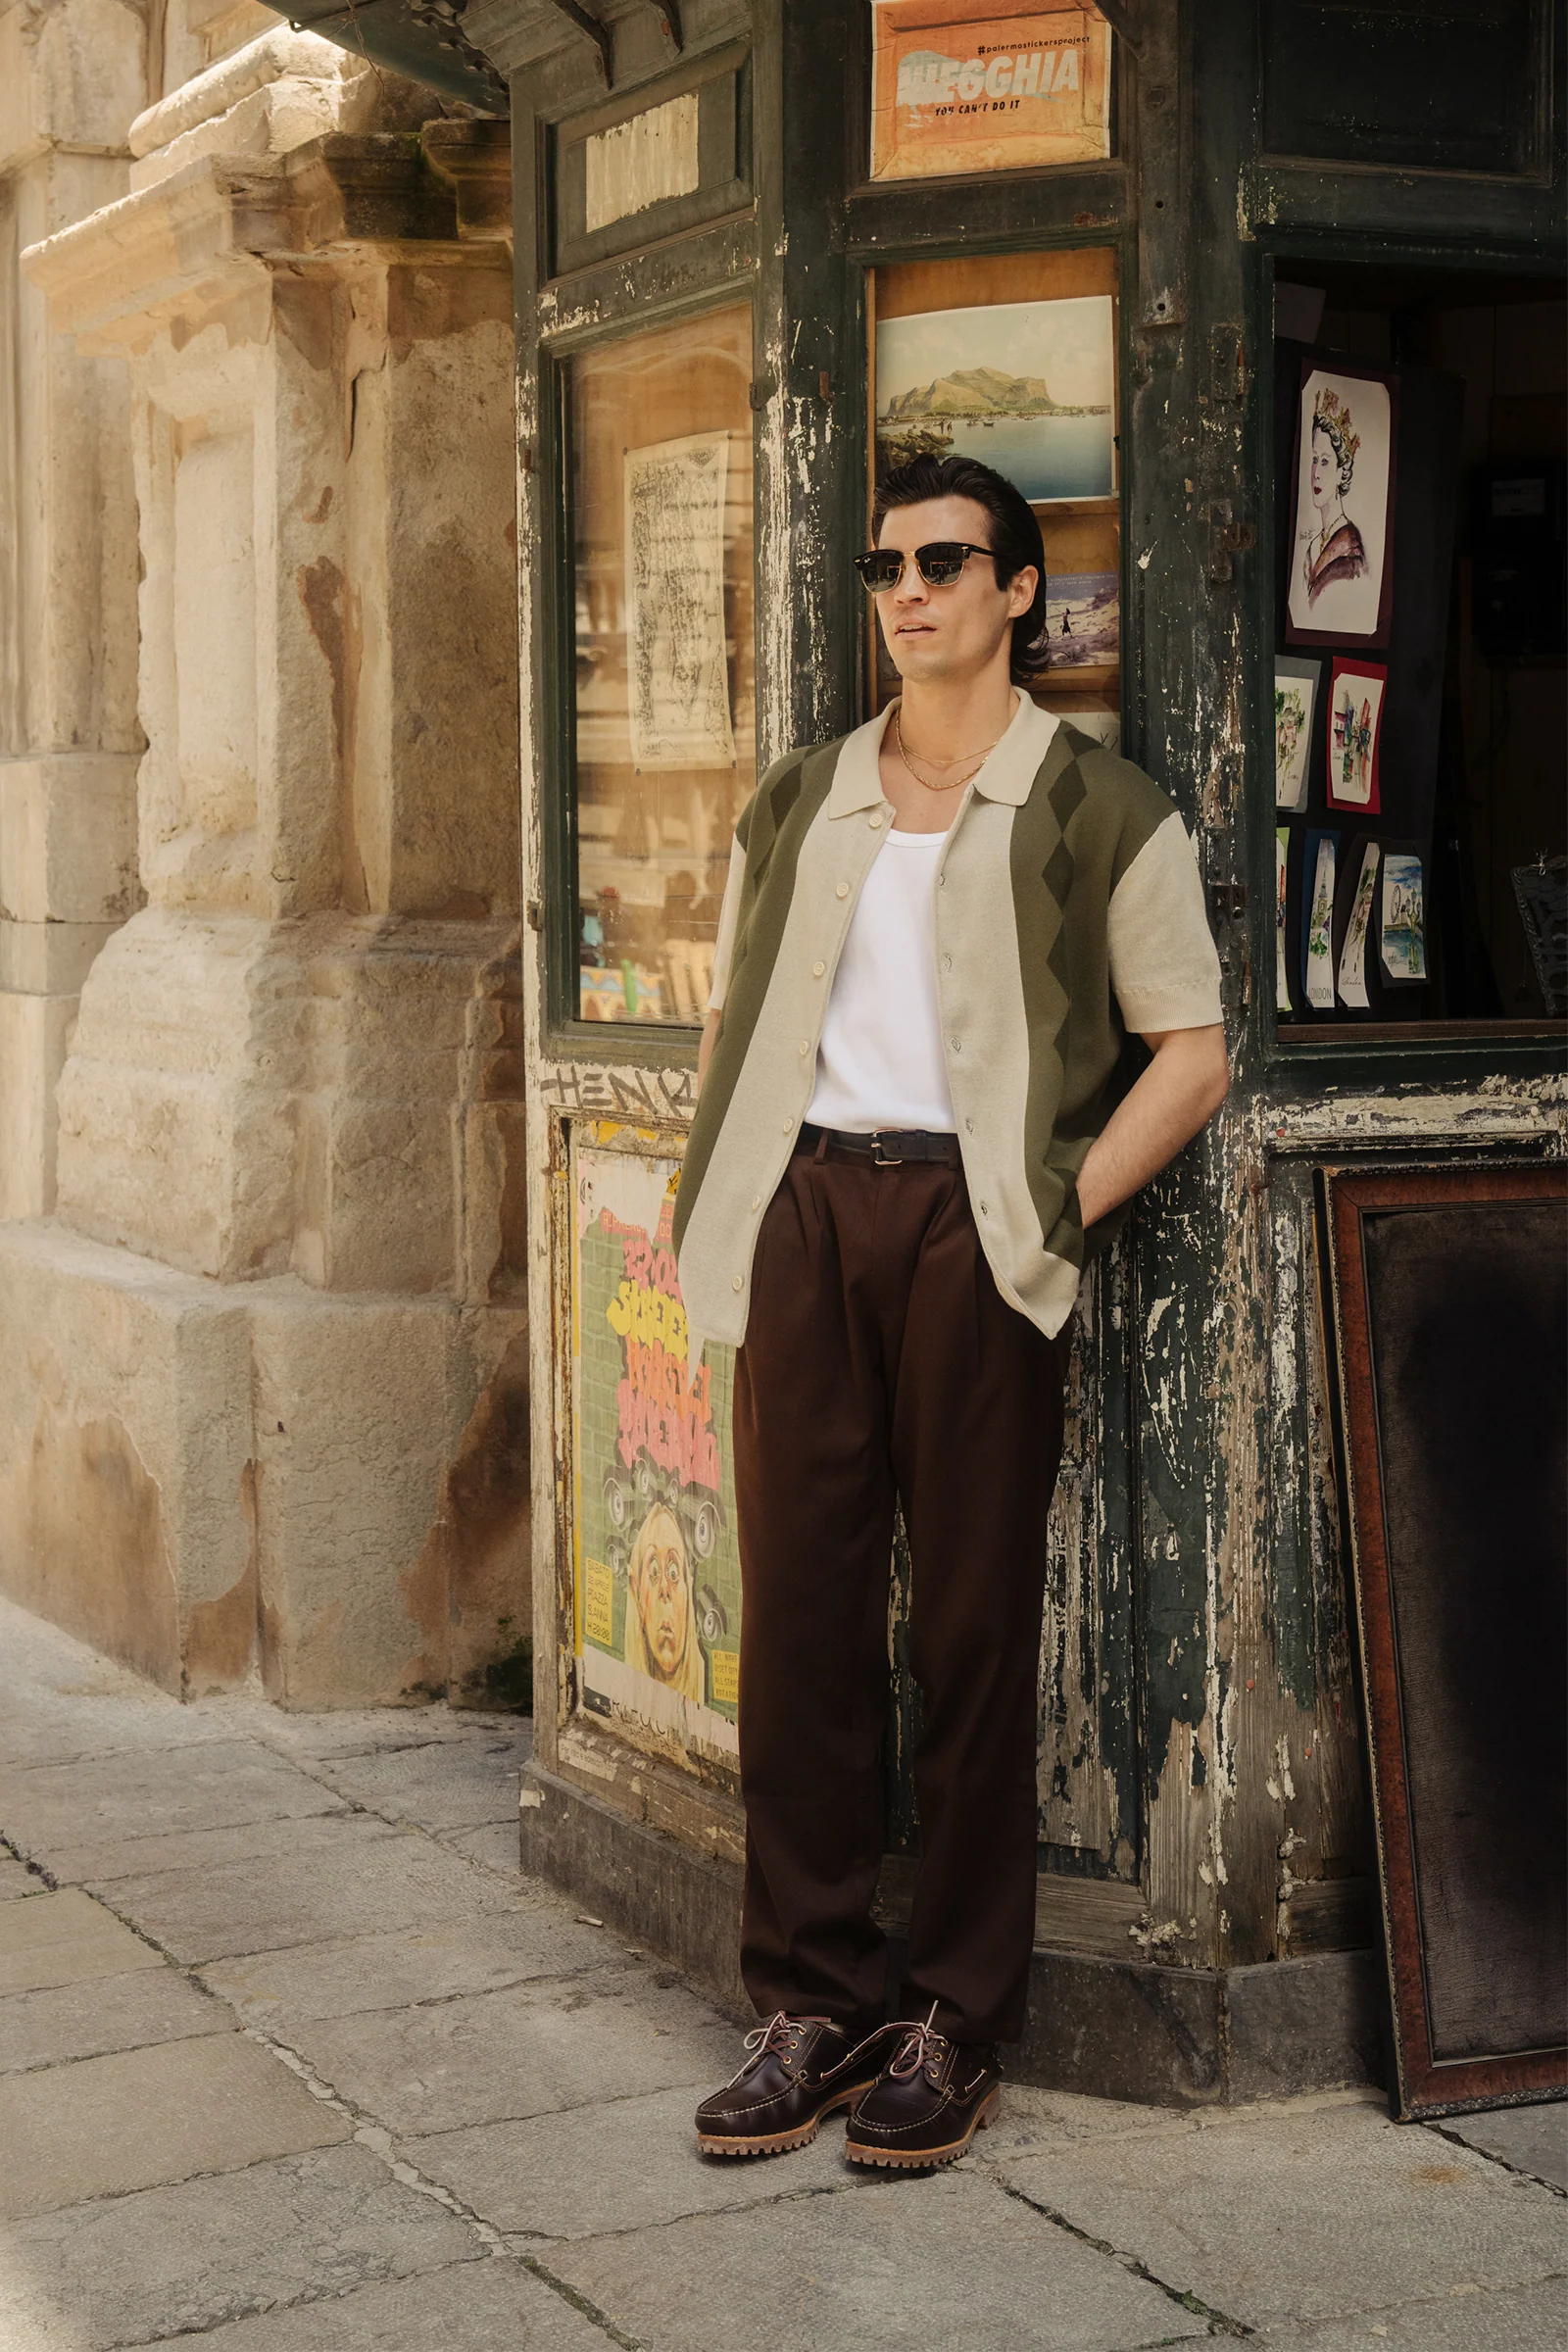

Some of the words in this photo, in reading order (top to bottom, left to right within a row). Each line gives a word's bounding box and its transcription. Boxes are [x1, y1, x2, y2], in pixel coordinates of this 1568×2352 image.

[977, 35, 1091, 56] #palermostickersproject
[935, 106, 955, 117] YOU
[958, 103, 988, 115] CAN'T
[992, 101, 1006, 111] DO
[1009, 100, 1020, 110] IT
